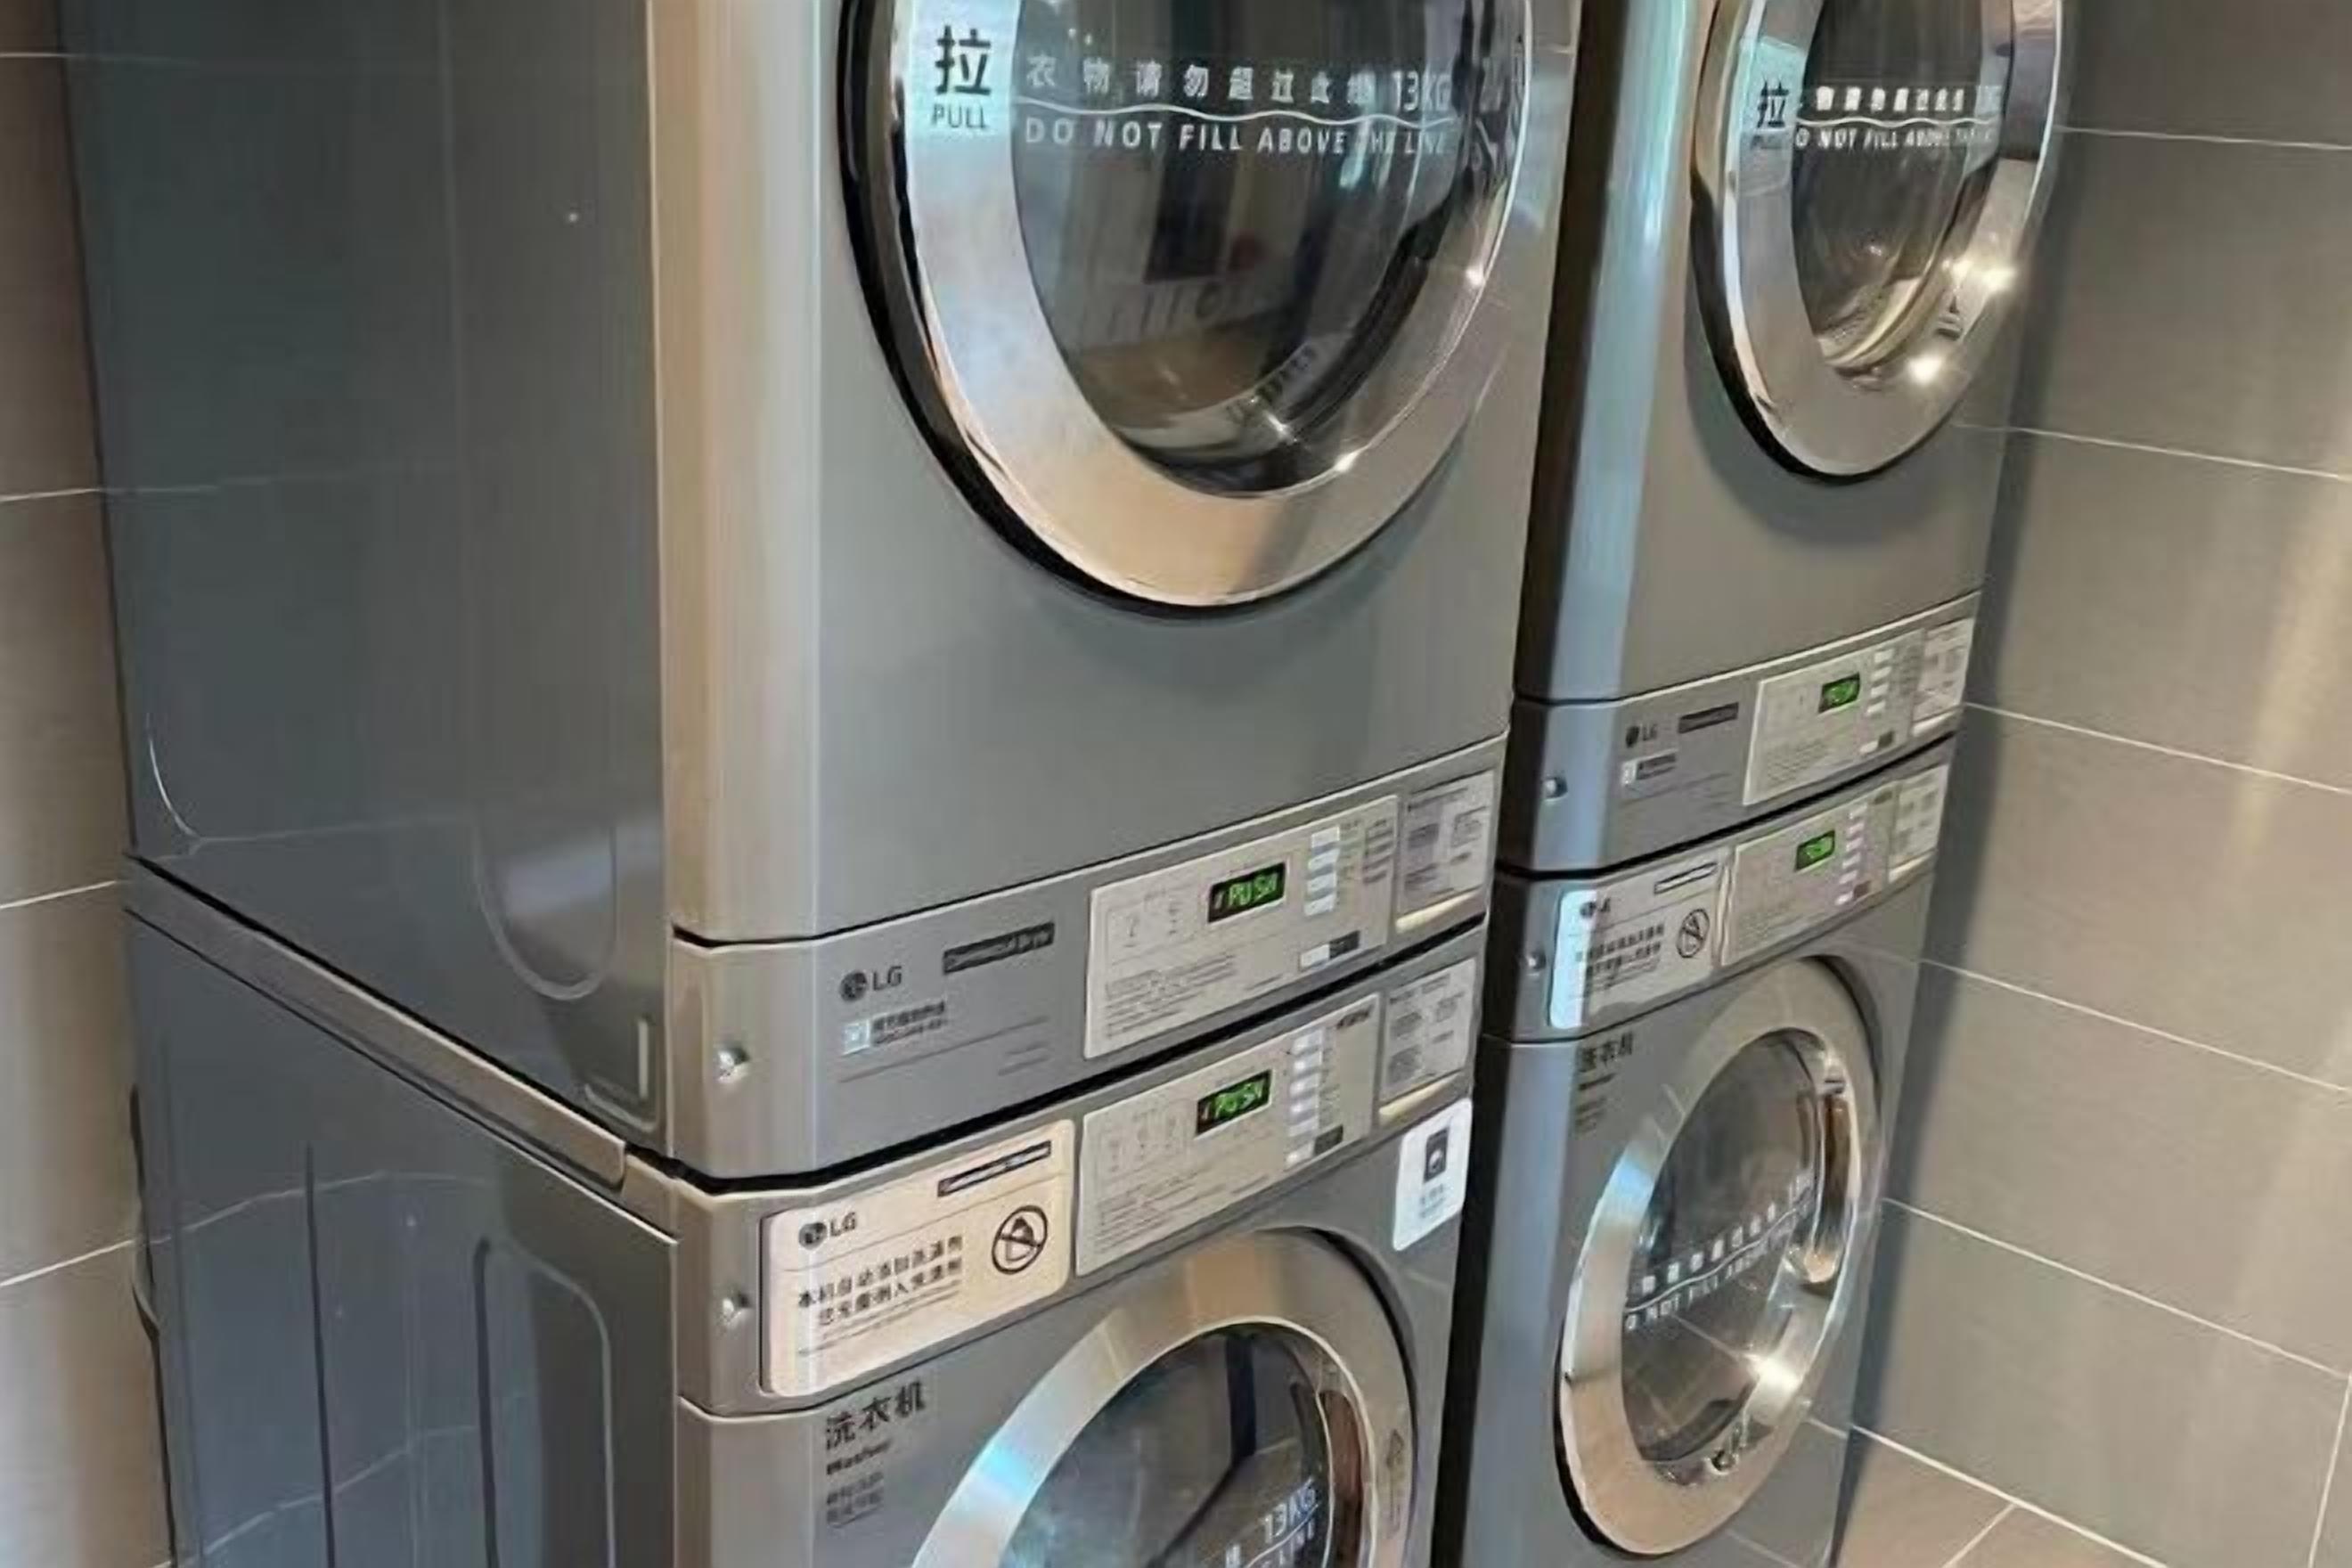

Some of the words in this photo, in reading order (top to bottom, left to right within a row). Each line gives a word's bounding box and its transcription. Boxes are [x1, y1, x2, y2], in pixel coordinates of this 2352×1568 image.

[935, 25, 992, 96] 拉
[931, 103, 988, 131] PULL
[1025, 117, 1074, 145] DO
[1093, 119, 1164, 151] NOT
[1179, 123, 1243, 151] FILL
[1256, 126, 1347, 155] ABOVE
[825, 1377, 927, 1451] 洗衣机
